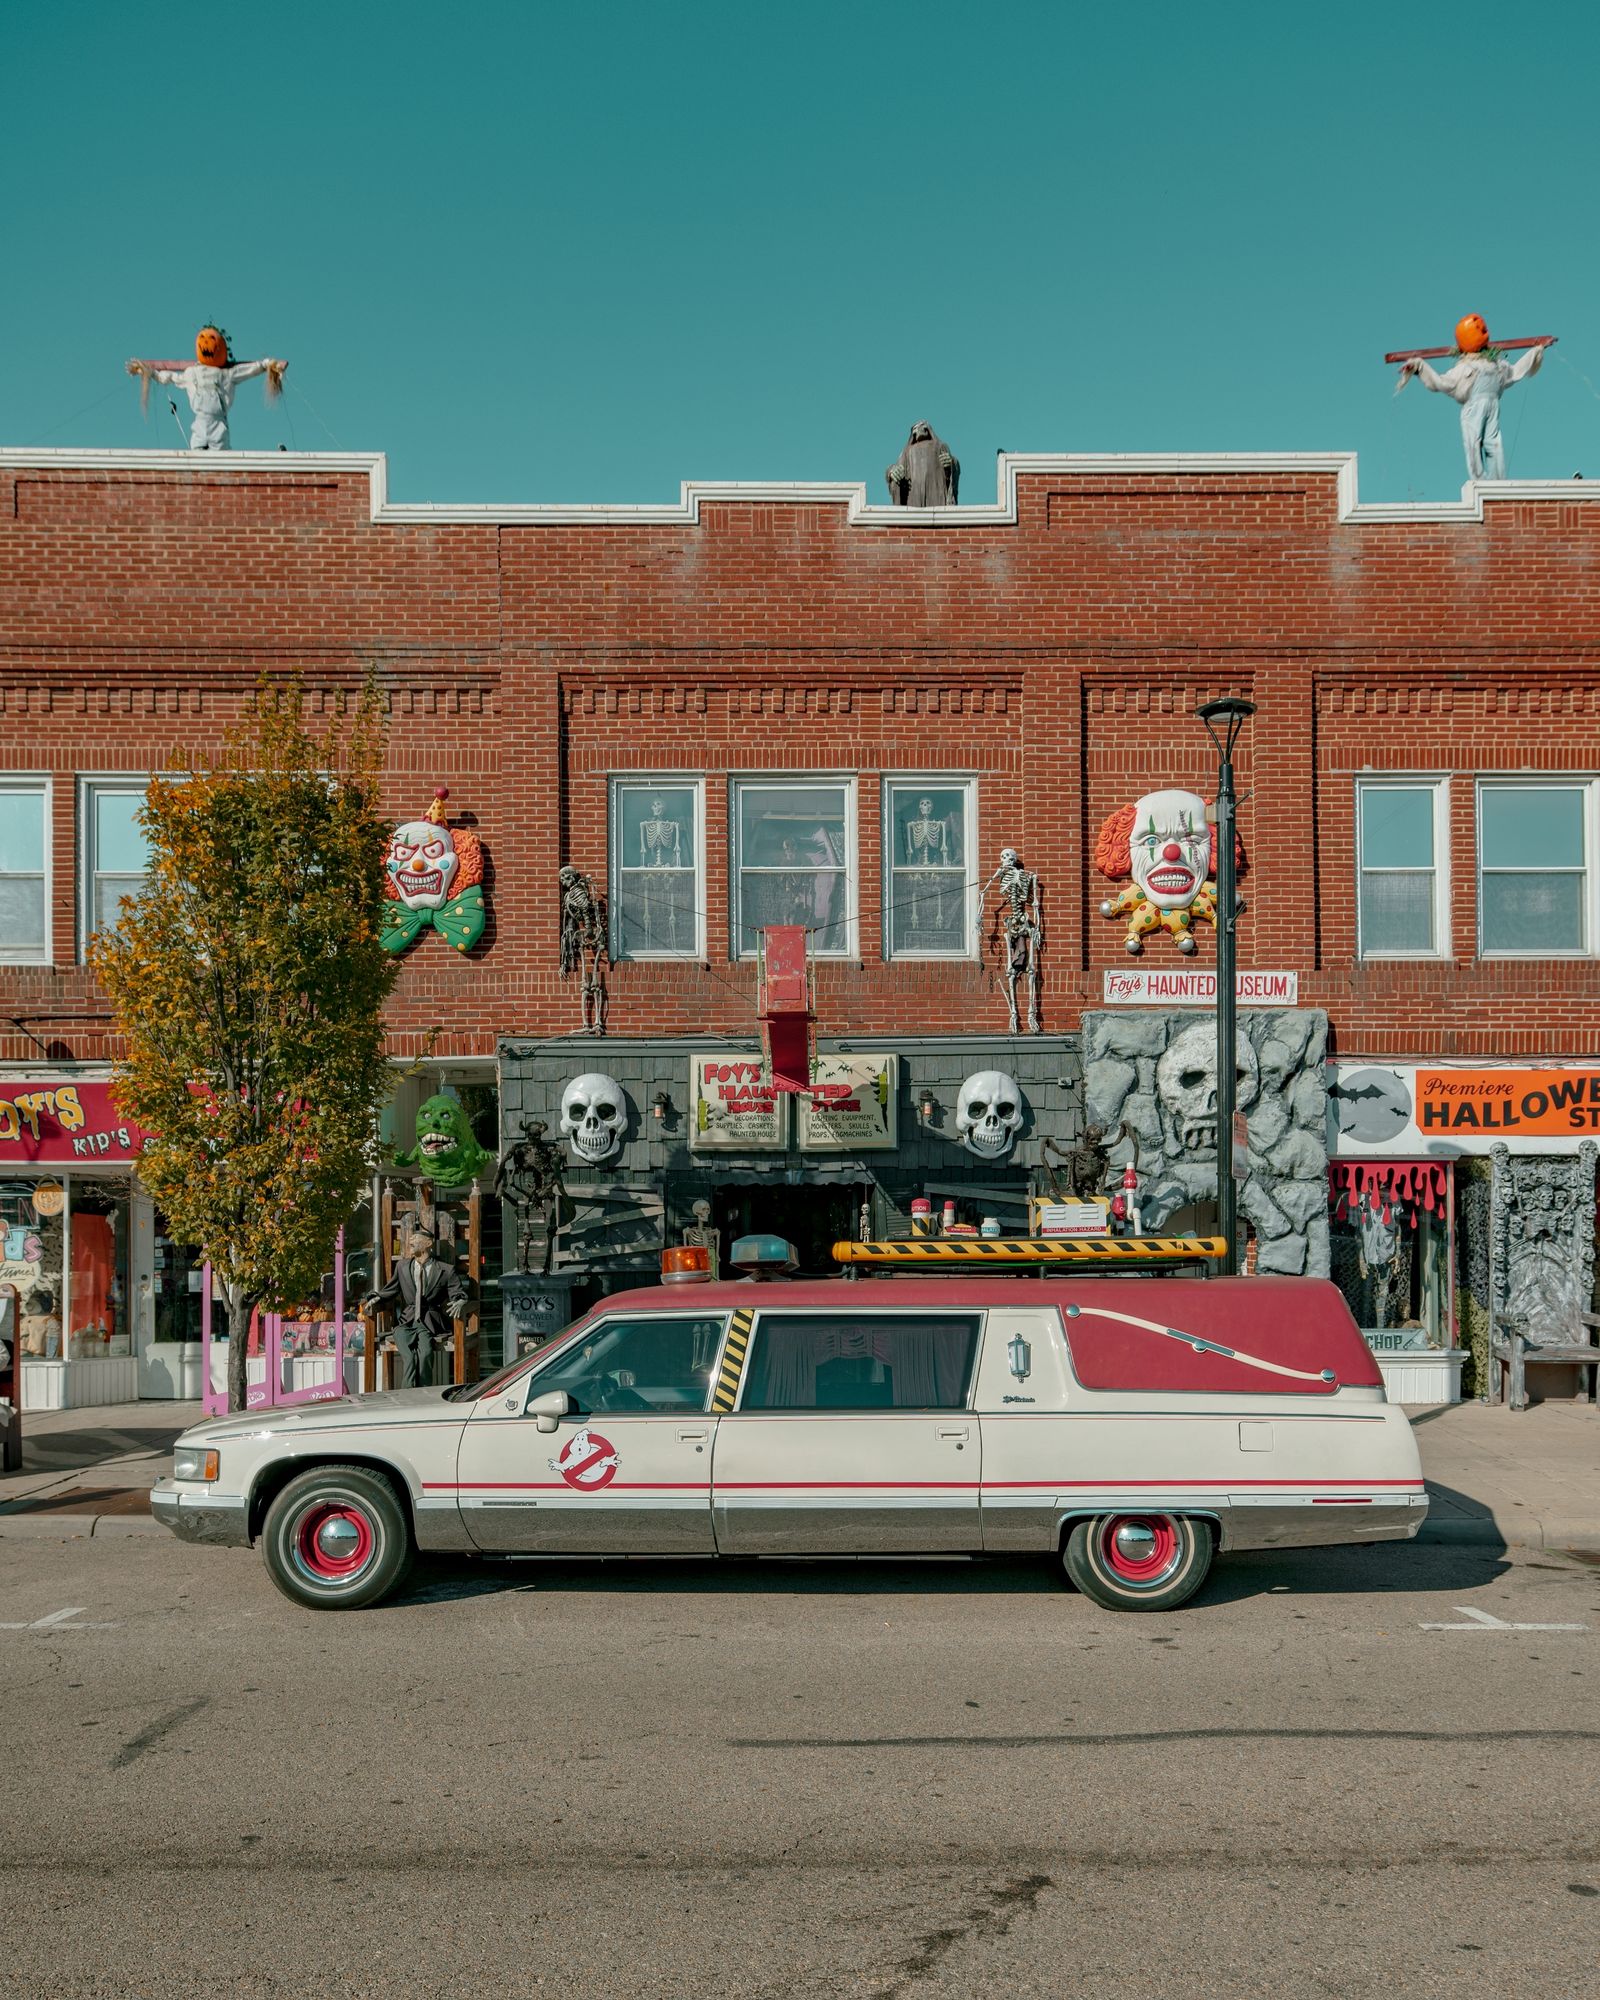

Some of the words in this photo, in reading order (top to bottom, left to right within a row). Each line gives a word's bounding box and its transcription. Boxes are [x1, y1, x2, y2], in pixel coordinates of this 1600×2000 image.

[1109, 975, 1142, 999] Foy's
[1147, 975, 1216, 997] HAUNTED
[1235, 976, 1288, 997] USEUM
[704, 1063, 761, 1084] FOY'S
[1424, 1077, 1514, 1096] Premiere
[727, 1101, 774, 1114] HOUSE
[811, 1100, 861, 1113] STORE
[72, 1127, 131, 1156] KID'S
[510, 1295, 555, 1311] FOY'S
